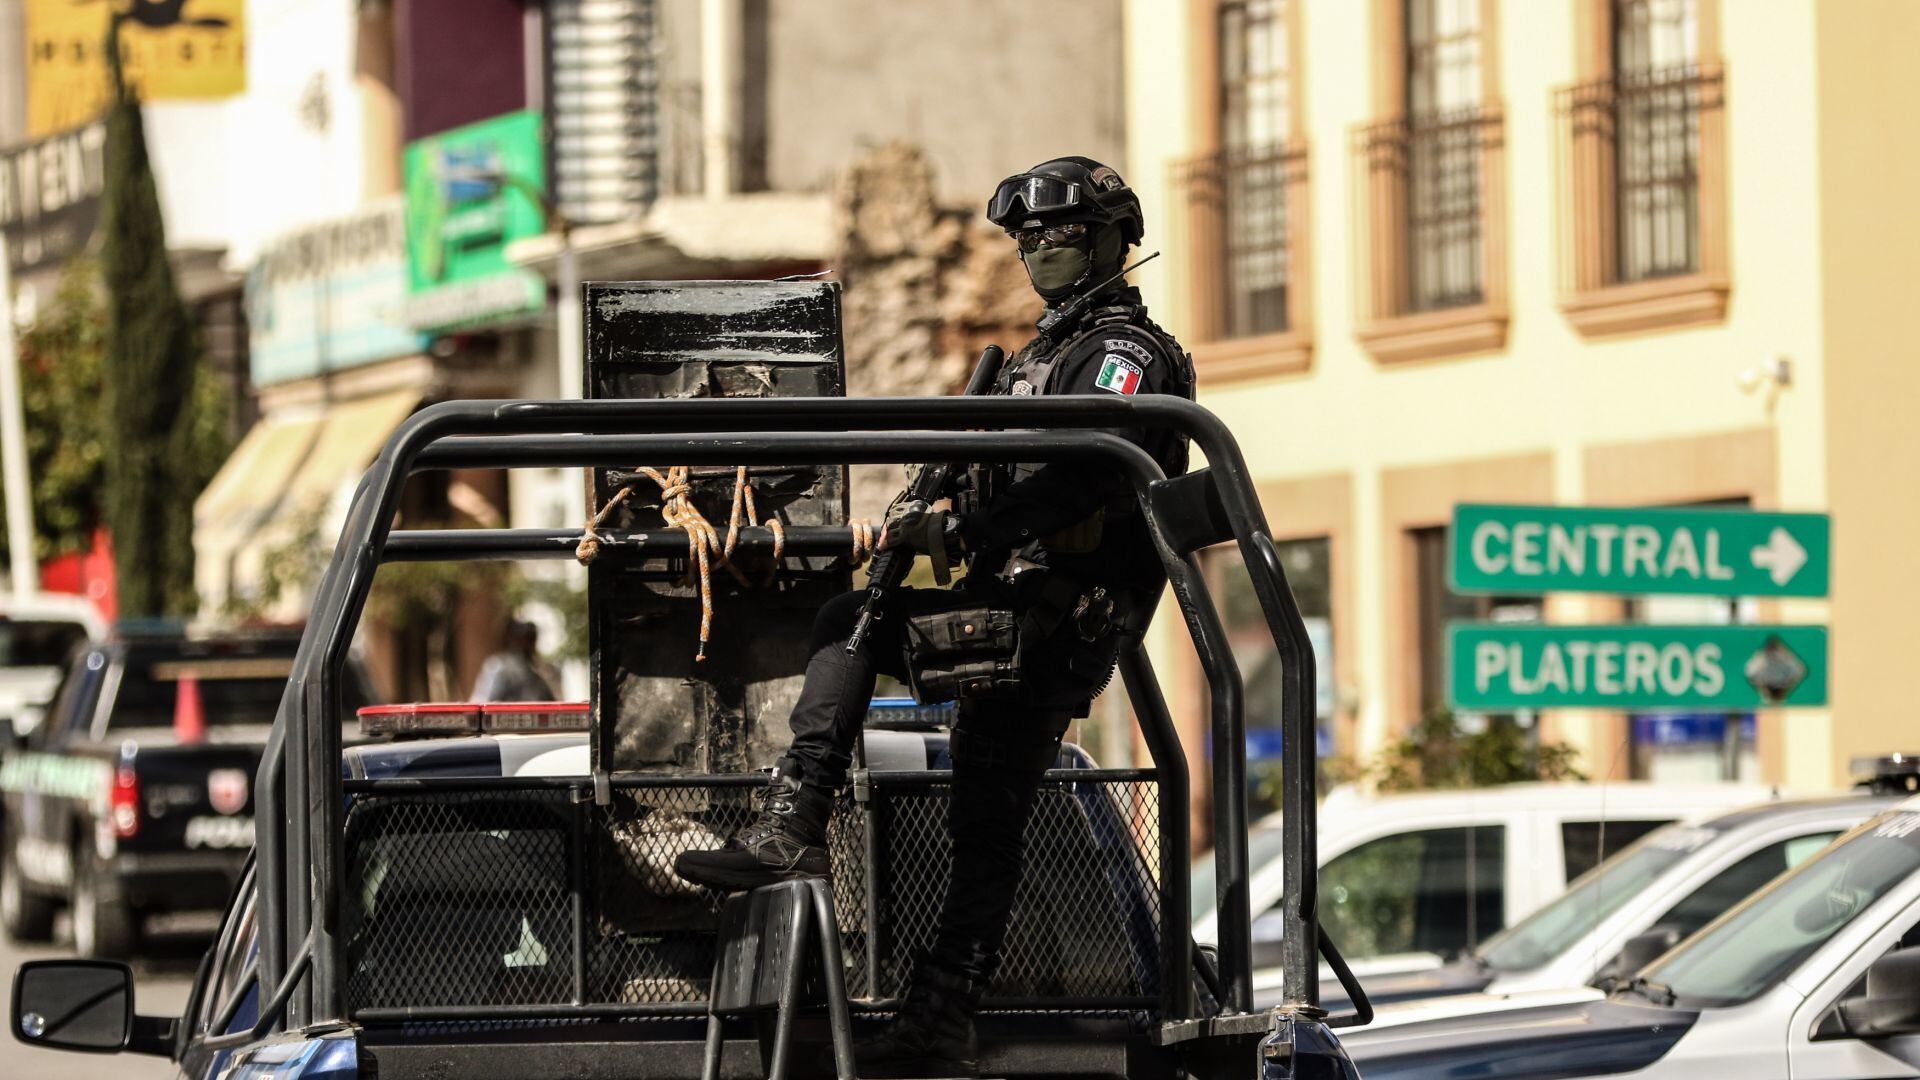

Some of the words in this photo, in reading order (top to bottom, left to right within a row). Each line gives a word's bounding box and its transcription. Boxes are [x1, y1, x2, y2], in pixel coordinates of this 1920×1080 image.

[1109, 357, 1140, 375] MEXICO
[1471, 520, 1735, 580] CENTRAL
[1475, 641, 1725, 696] PLATEROS
